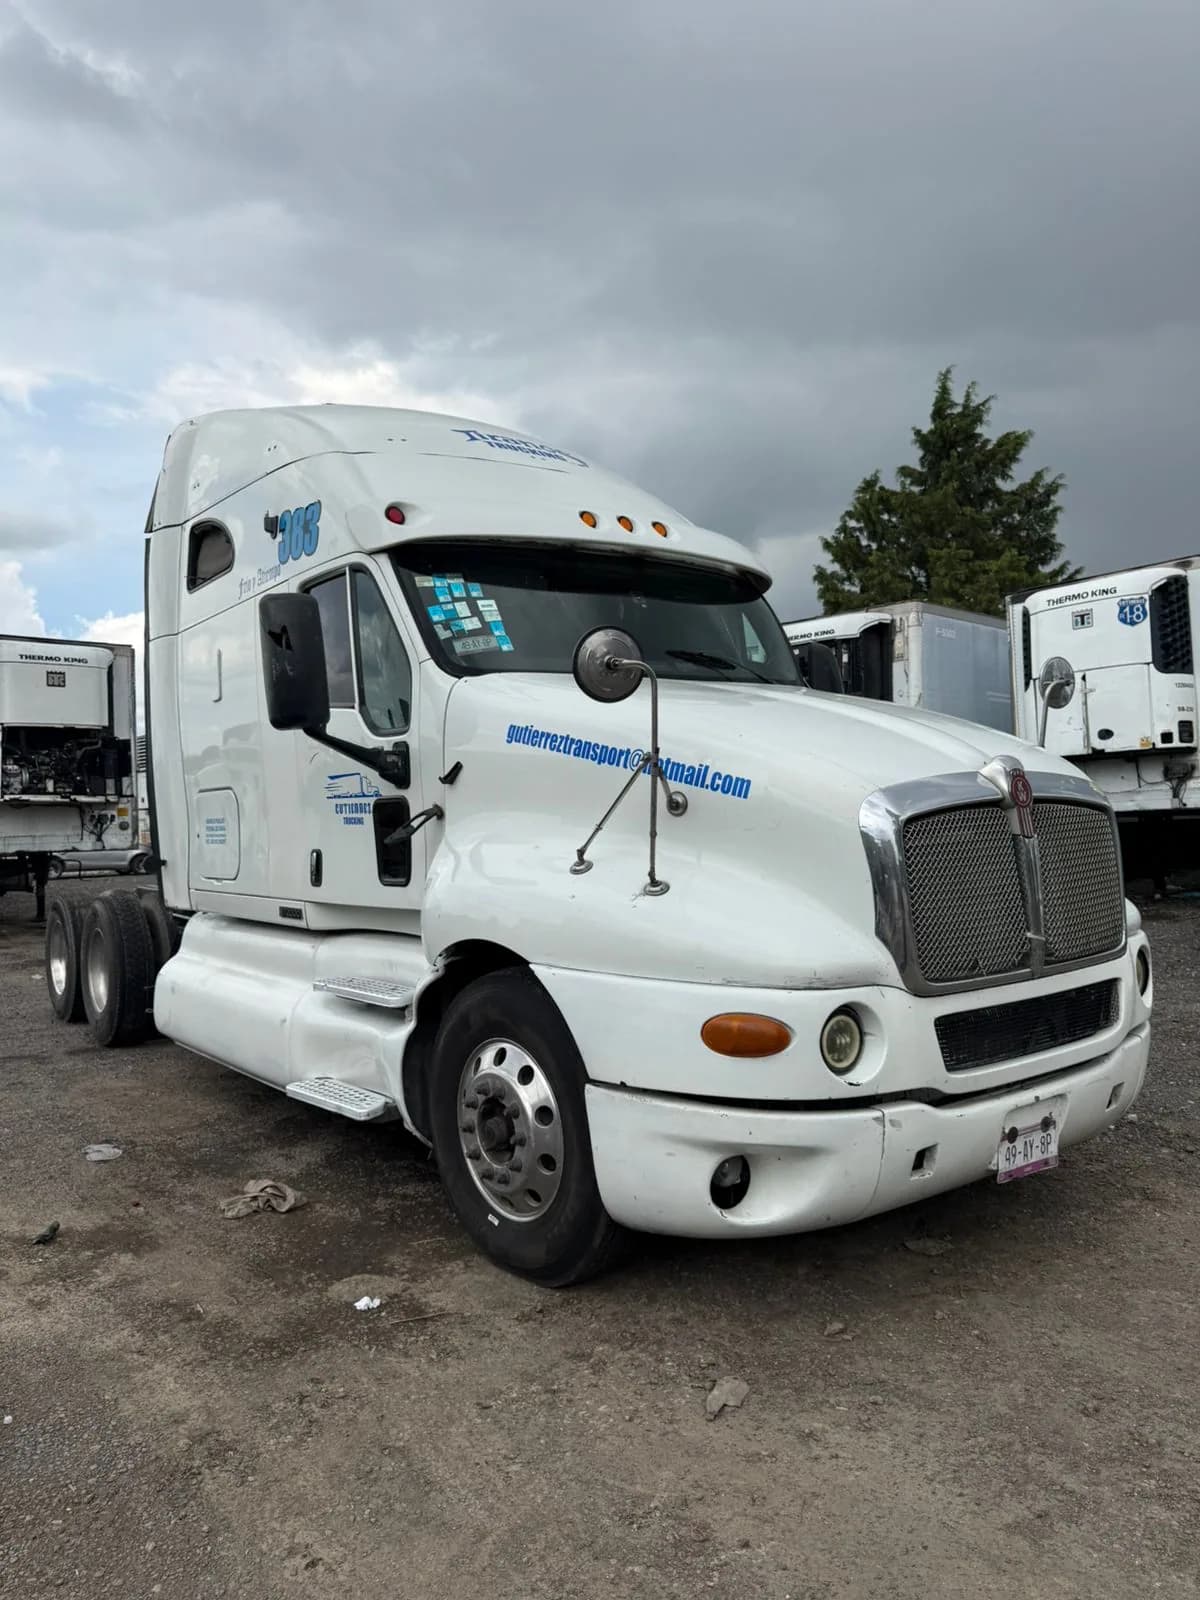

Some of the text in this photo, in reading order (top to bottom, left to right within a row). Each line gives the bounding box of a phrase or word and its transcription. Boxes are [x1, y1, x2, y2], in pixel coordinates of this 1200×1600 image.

[278, 499, 321, 565] 383
[1047, 586, 1118, 607] THERMO KING
[814, 629, 835, 637] KING
[18, 654, 61, 662] THERMO
[1005, 1132, 1052, 1166] 49-AY-8P
